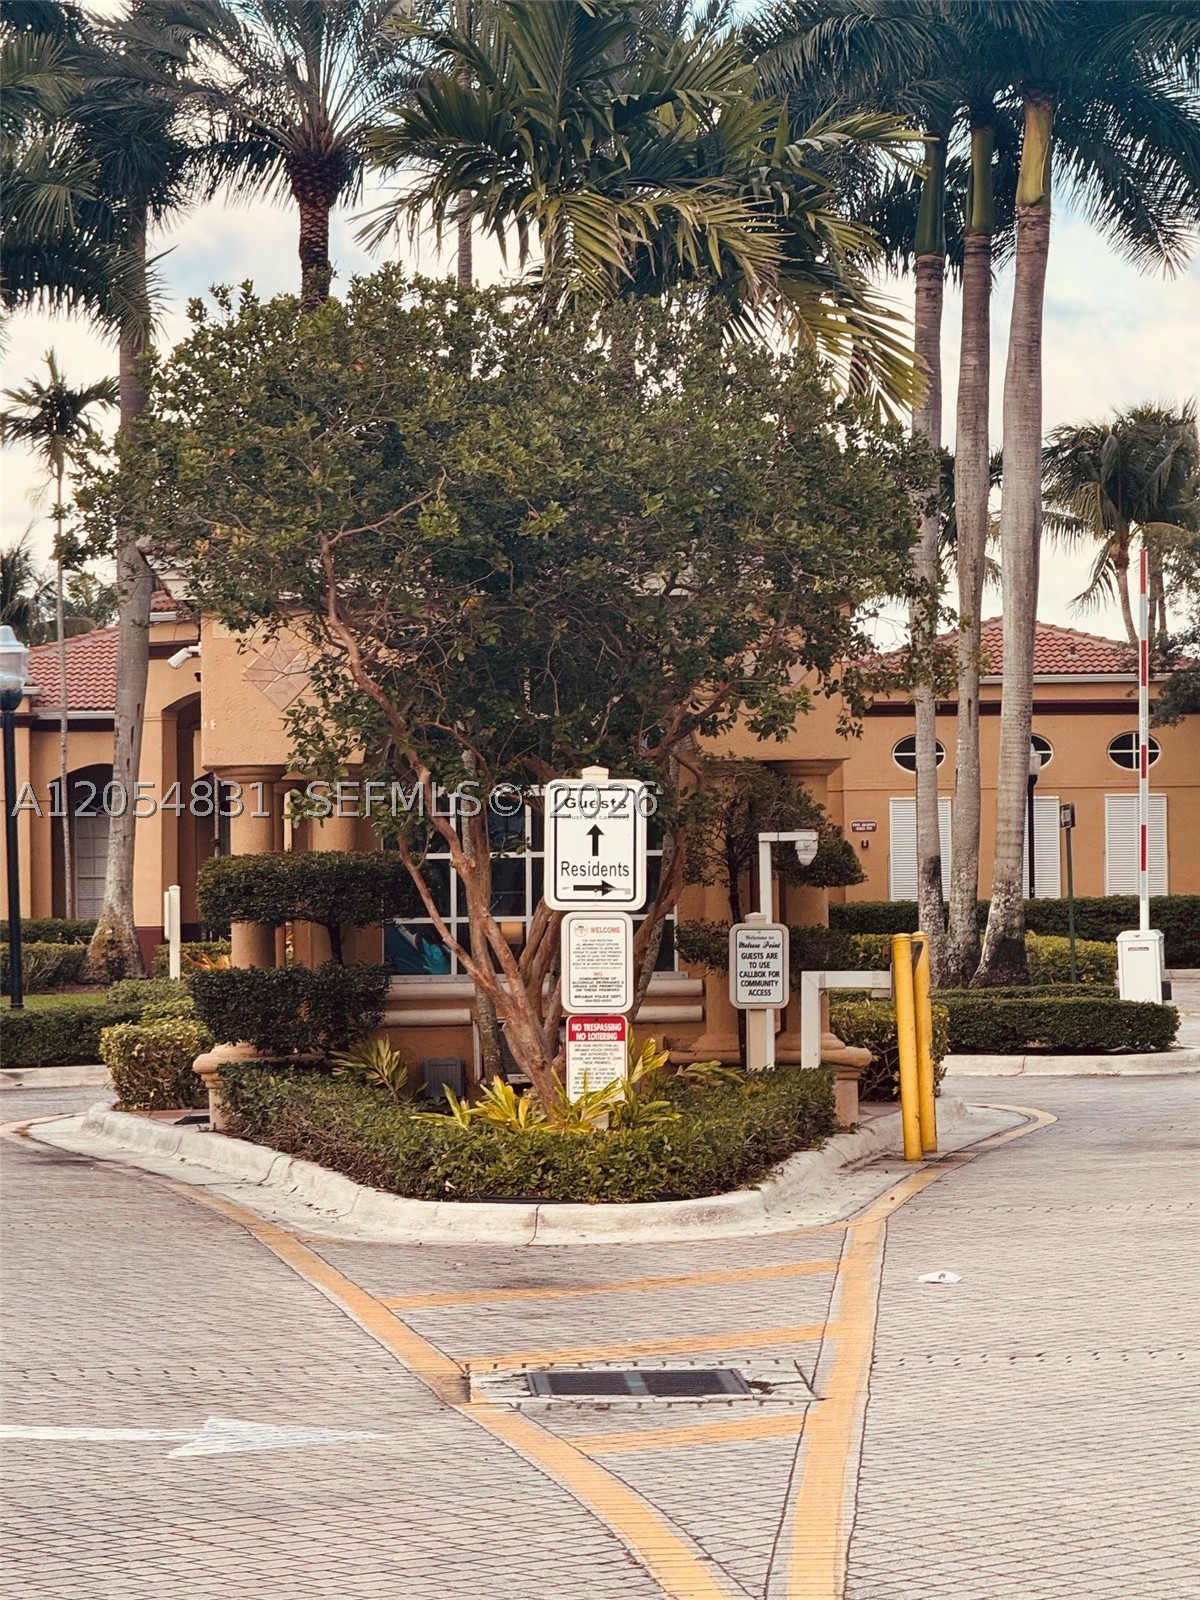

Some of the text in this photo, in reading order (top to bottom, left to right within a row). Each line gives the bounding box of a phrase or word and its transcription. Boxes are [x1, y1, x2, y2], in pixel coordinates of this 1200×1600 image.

[564, 798, 626, 809] Guests
[561, 861, 630, 877] Residents
[572, 1023, 622, 1031] NO TRESPASSING
